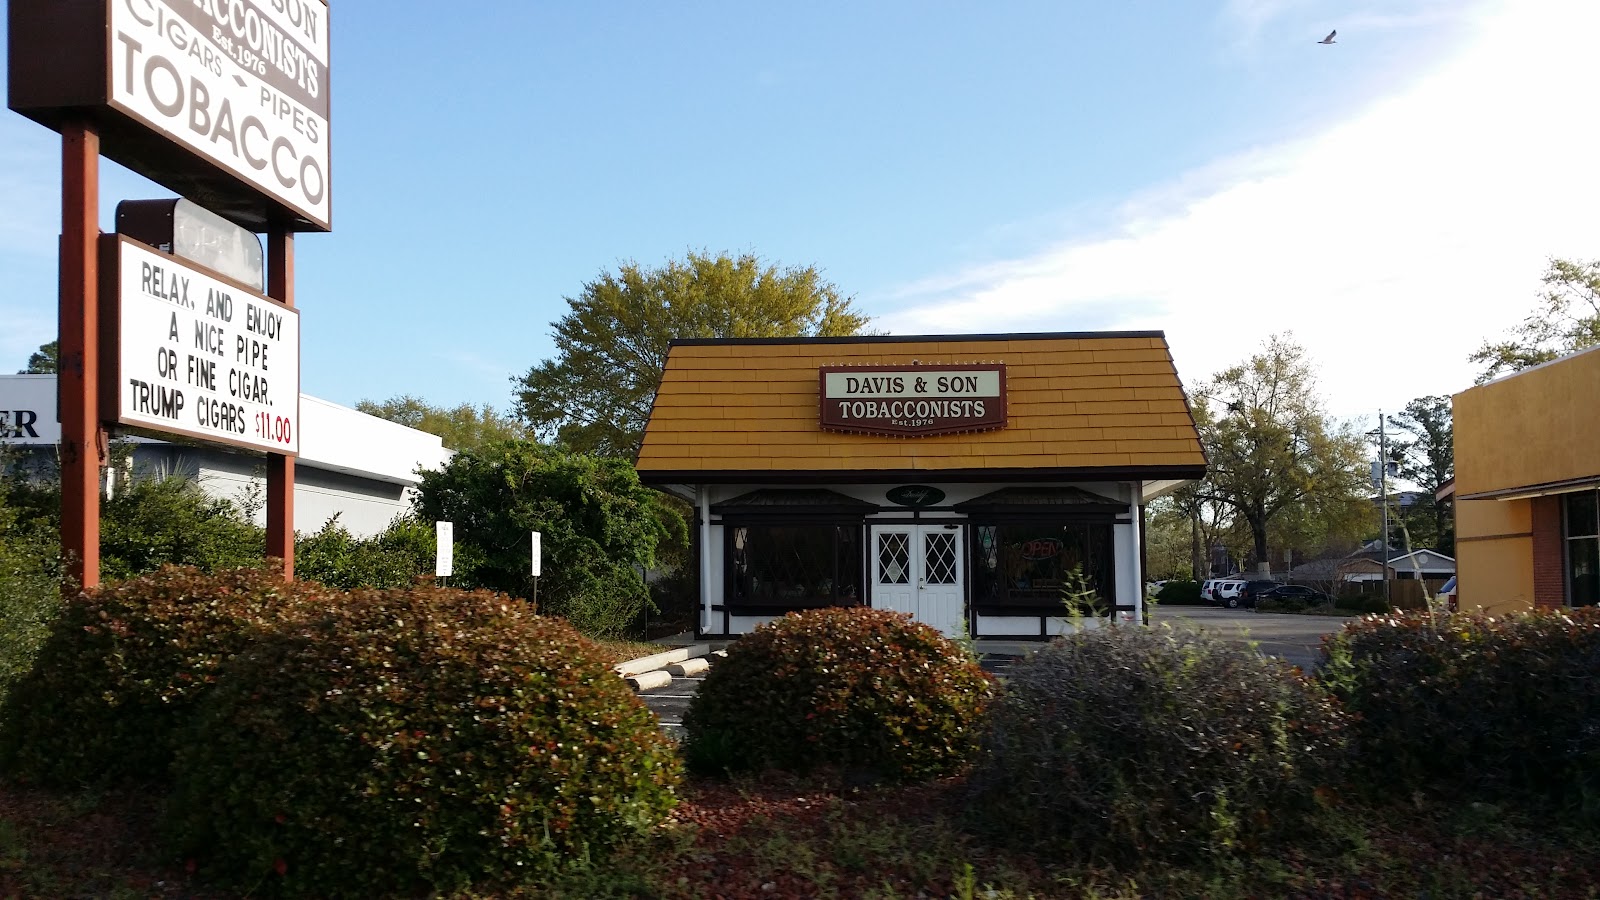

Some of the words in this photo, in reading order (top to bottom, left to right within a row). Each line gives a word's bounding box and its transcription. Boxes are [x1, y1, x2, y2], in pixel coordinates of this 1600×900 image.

[123, 0, 222, 77] CIGARS
[211, 24, 267, 75] Est.1976
[117, 30, 324, 206] TOBACCO
[260, 85, 319, 144] PIPES
[141, 260, 195, 311] RELAX,
[206, 287, 233, 323] AND
[246, 302, 283, 342] ENJOY
[168, 311, 179, 343] A
[194, 318, 225, 357] NICE
[236, 334, 268, 371] PIPE
[157, 346, 178, 381] OR
[187, 354, 217, 392] FINE
[229, 367, 273, 407] CIGAR.
[846, 377, 905, 394] DAVIS
[914, 377, 928, 393] &
[937, 376, 978, 393] SON
[129, 378, 185, 420] TRUMP
[196, 395, 246, 434] CIGARS
[255, 410, 291, 444] $11.00
[839, 400, 986, 419] TOBACCONISTS
[891, 419, 934, 427] Est.1976
[1022, 541, 1058, 557] OPEN
